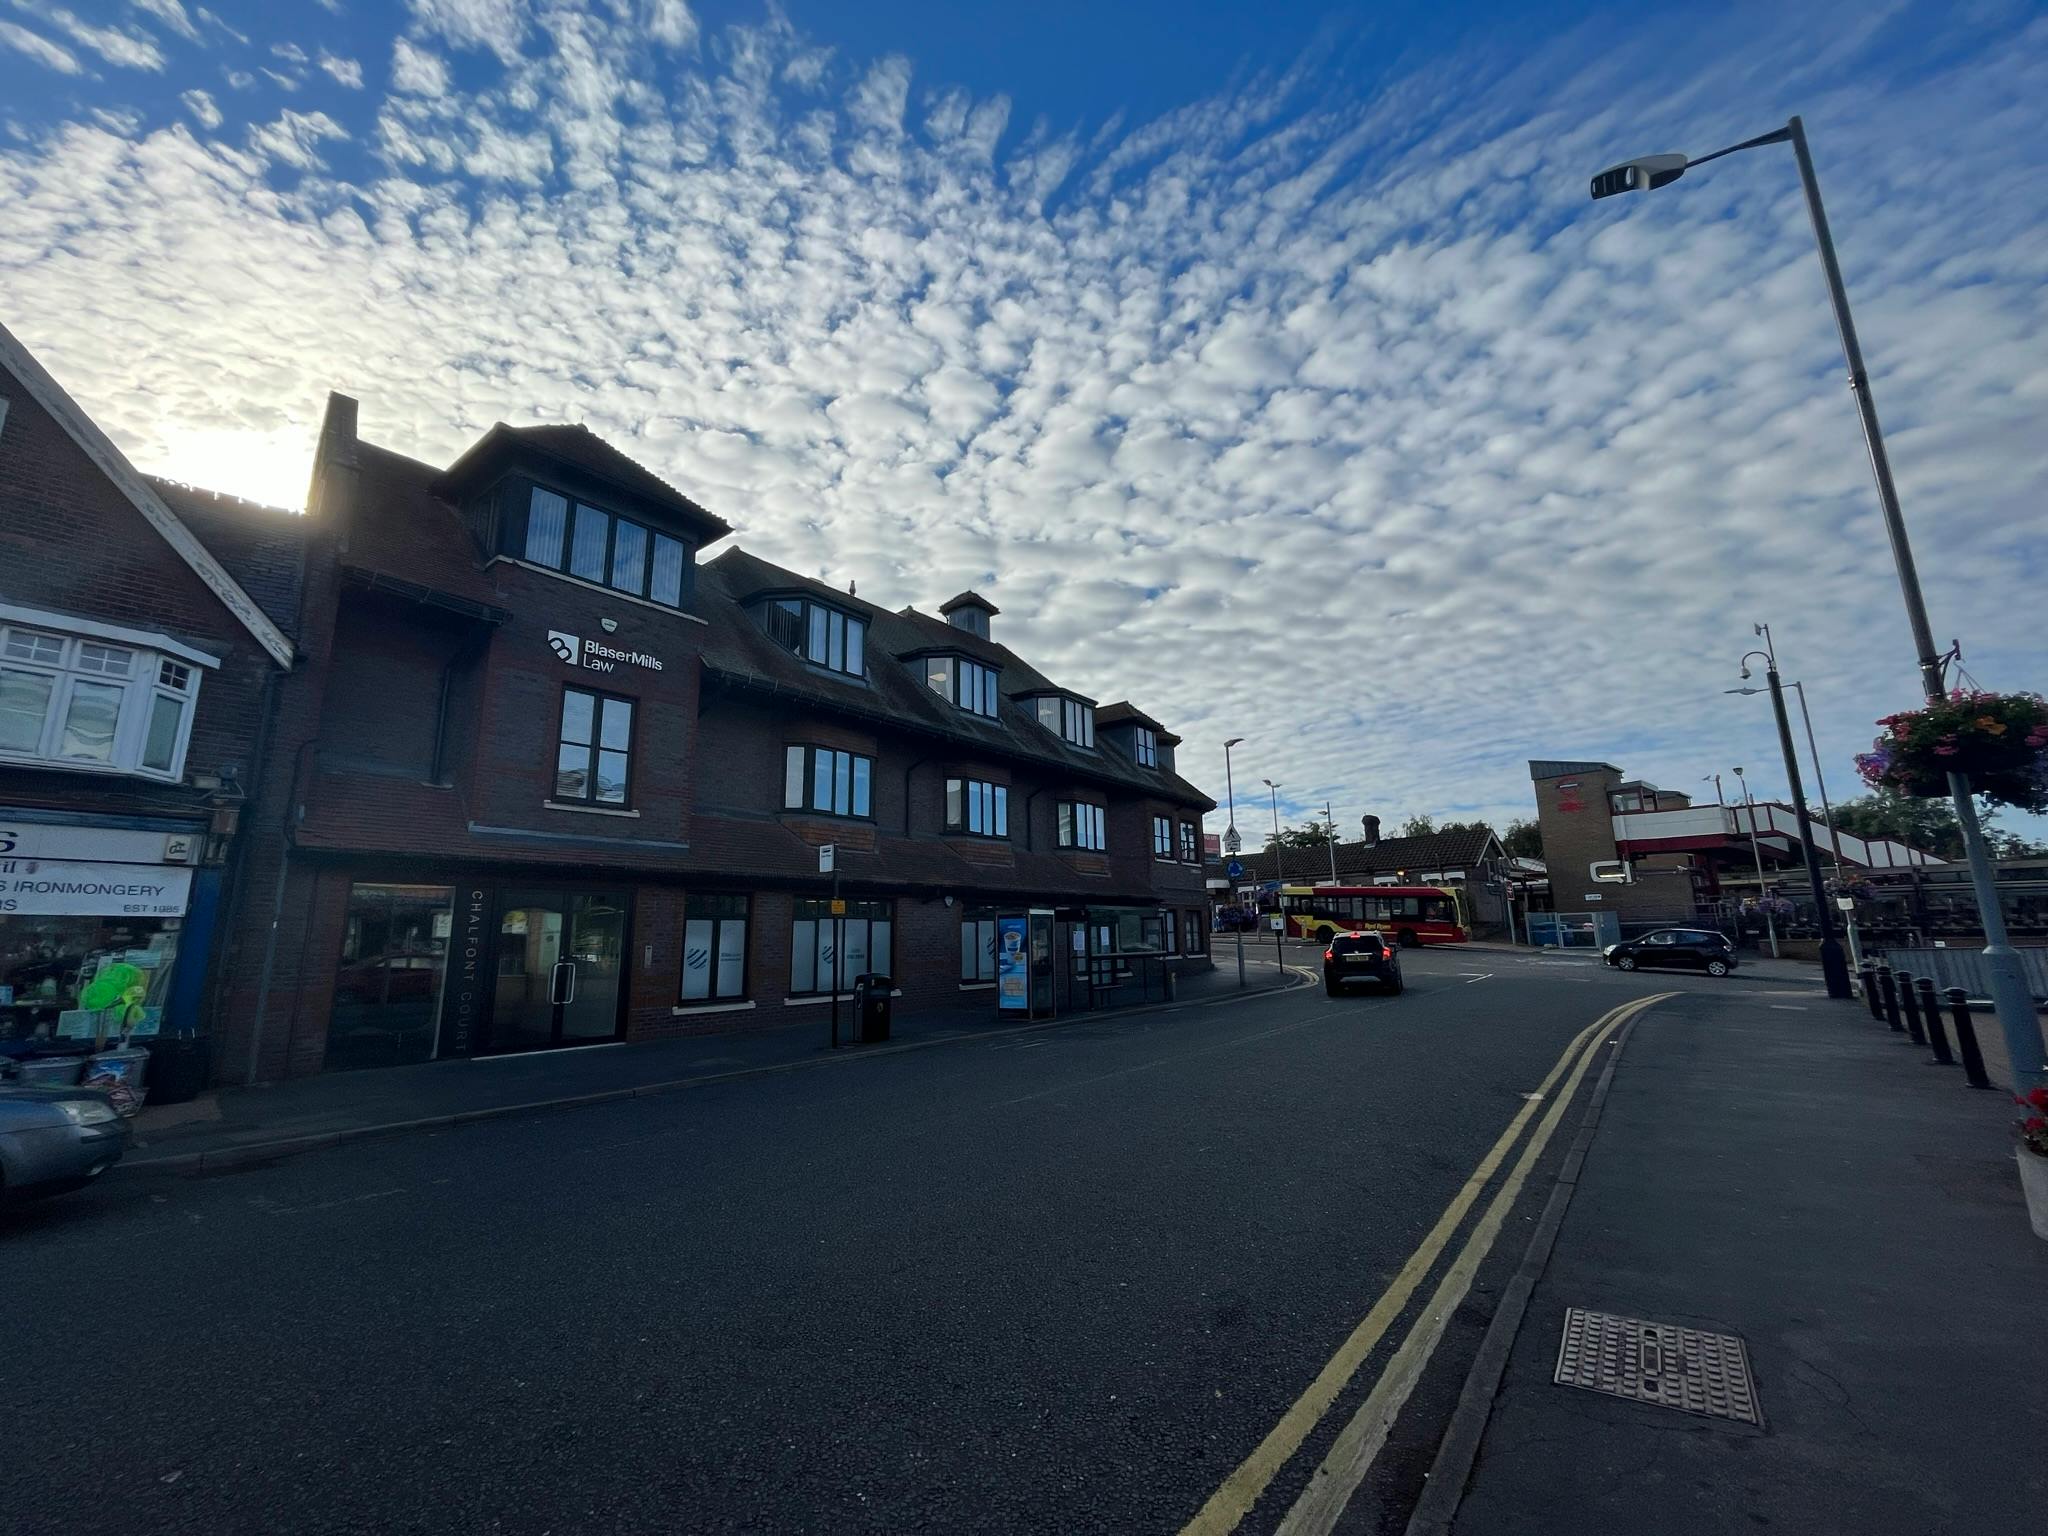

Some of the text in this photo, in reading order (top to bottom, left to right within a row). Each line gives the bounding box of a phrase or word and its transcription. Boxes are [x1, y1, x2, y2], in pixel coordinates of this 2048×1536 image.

[583, 653, 615, 673] Law
[584, 639, 663, 671] BlaserMills
[13, 880, 165, 897] IRONMONGERY
[123, 904, 148, 912] EST
[455, 890, 484, 1051] CHALFONT COURT
